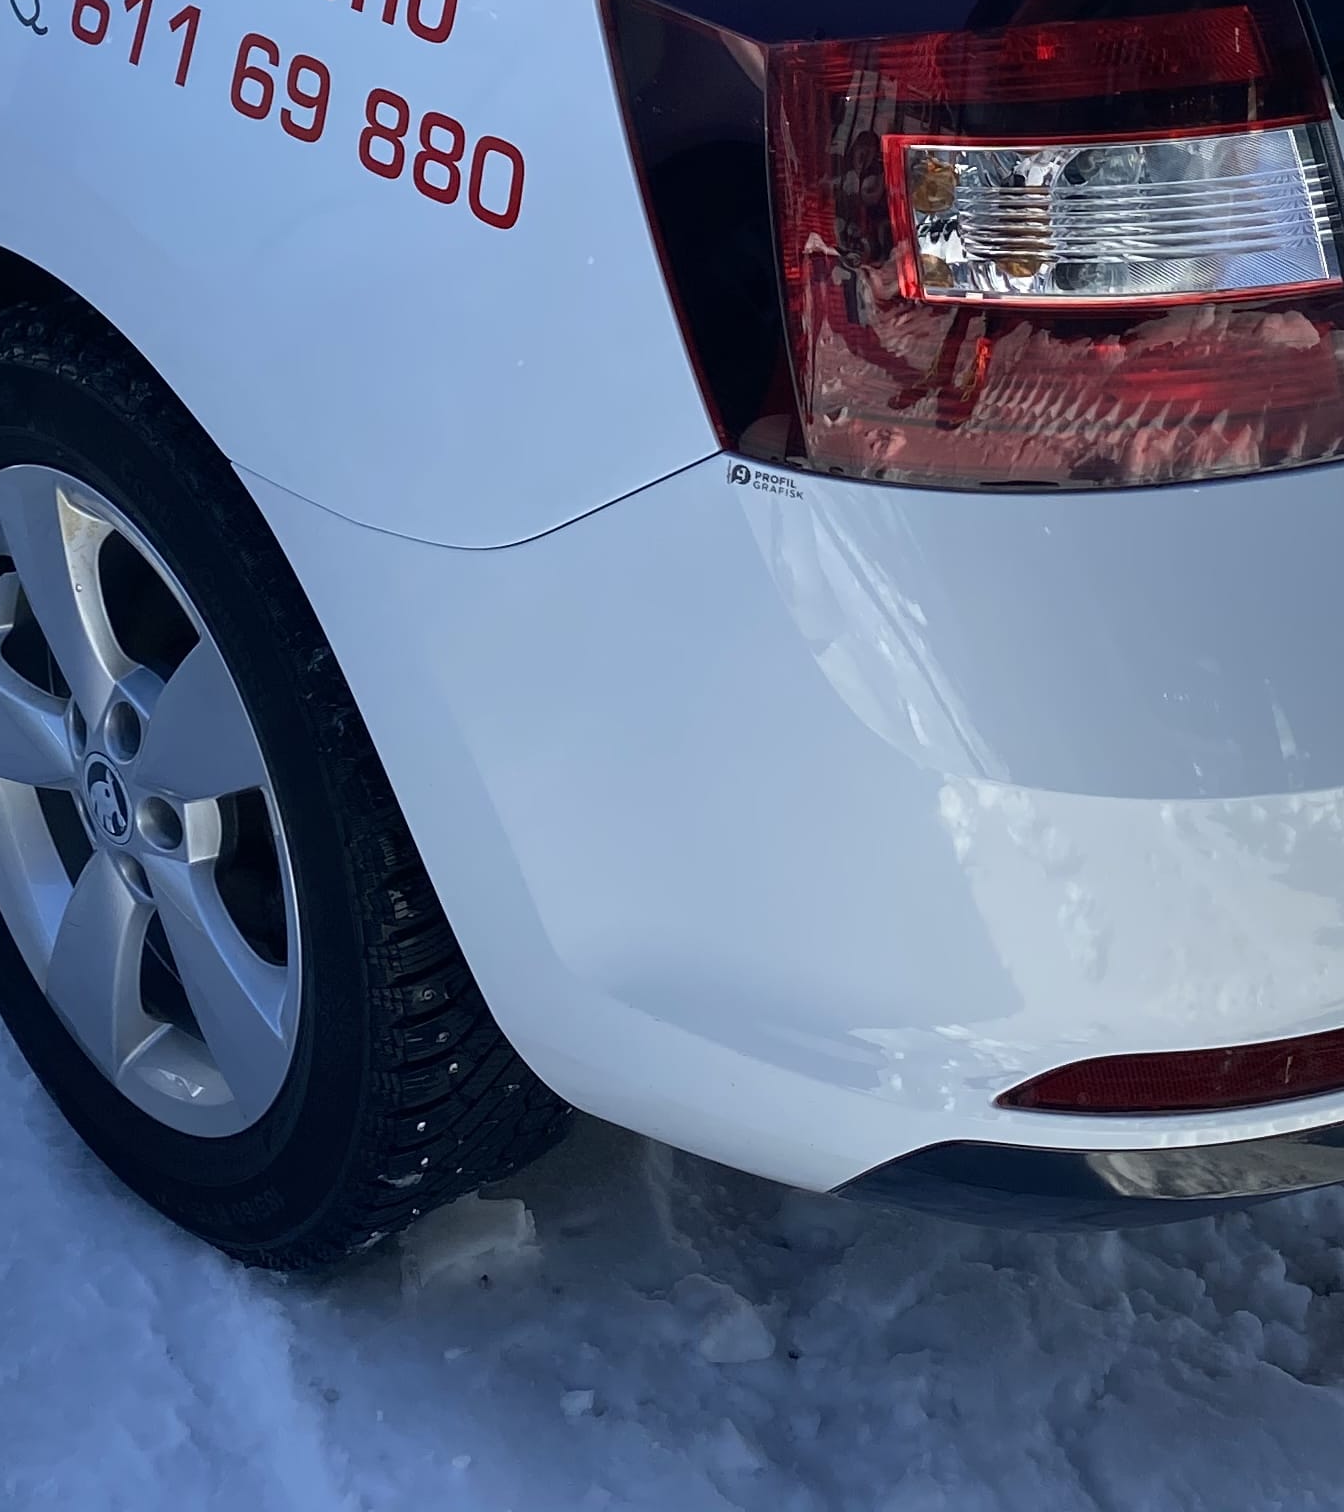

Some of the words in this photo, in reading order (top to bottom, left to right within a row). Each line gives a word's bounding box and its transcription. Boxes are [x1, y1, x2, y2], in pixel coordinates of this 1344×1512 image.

[229, 32, 332, 144] 69
[358, 87, 525, 230] 880
[754, 470, 798, 489] PROFIL
[752, 480, 805, 501] GRAFISK
